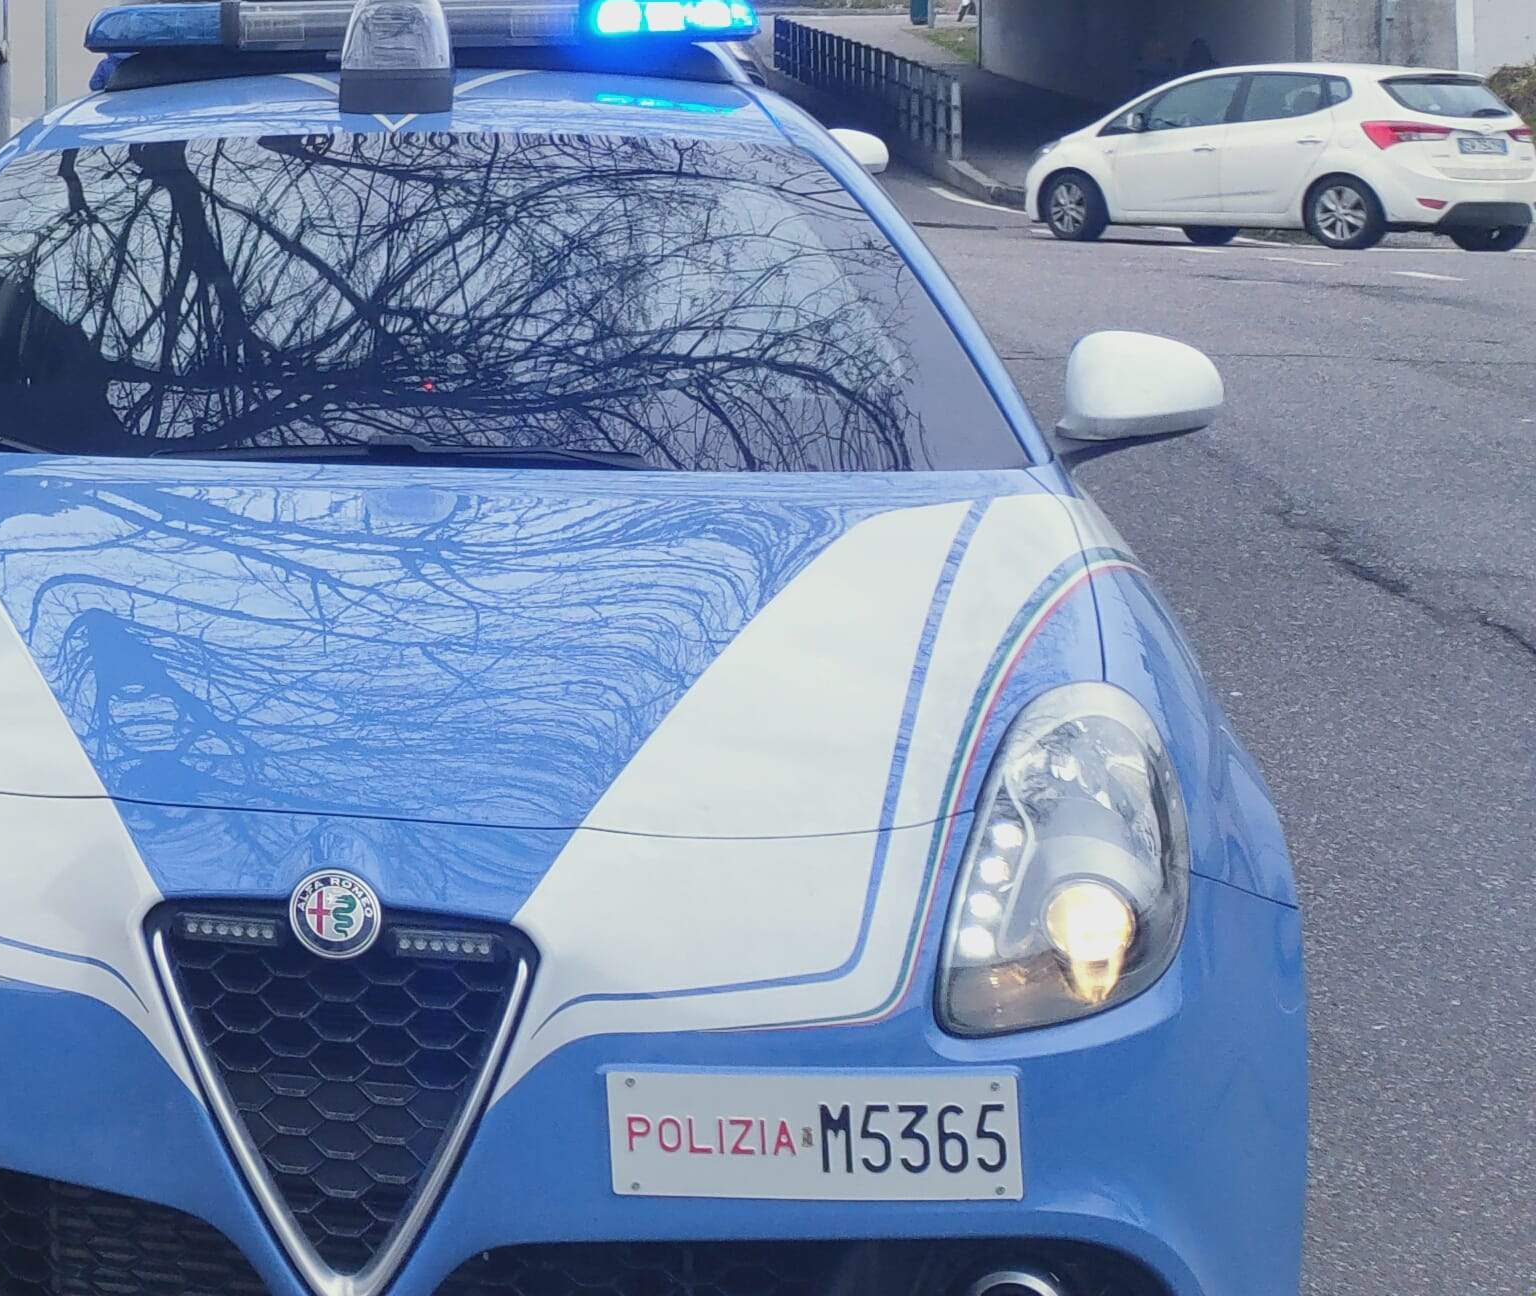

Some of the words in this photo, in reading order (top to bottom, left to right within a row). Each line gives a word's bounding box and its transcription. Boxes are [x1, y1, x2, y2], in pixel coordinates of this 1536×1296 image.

[297, 880, 324, 912] ALFA
[330, 877, 374, 918] ROMEO
[625, 1116, 796, 1156] POLIZIA
[819, 1103, 1007, 1174] M5365
